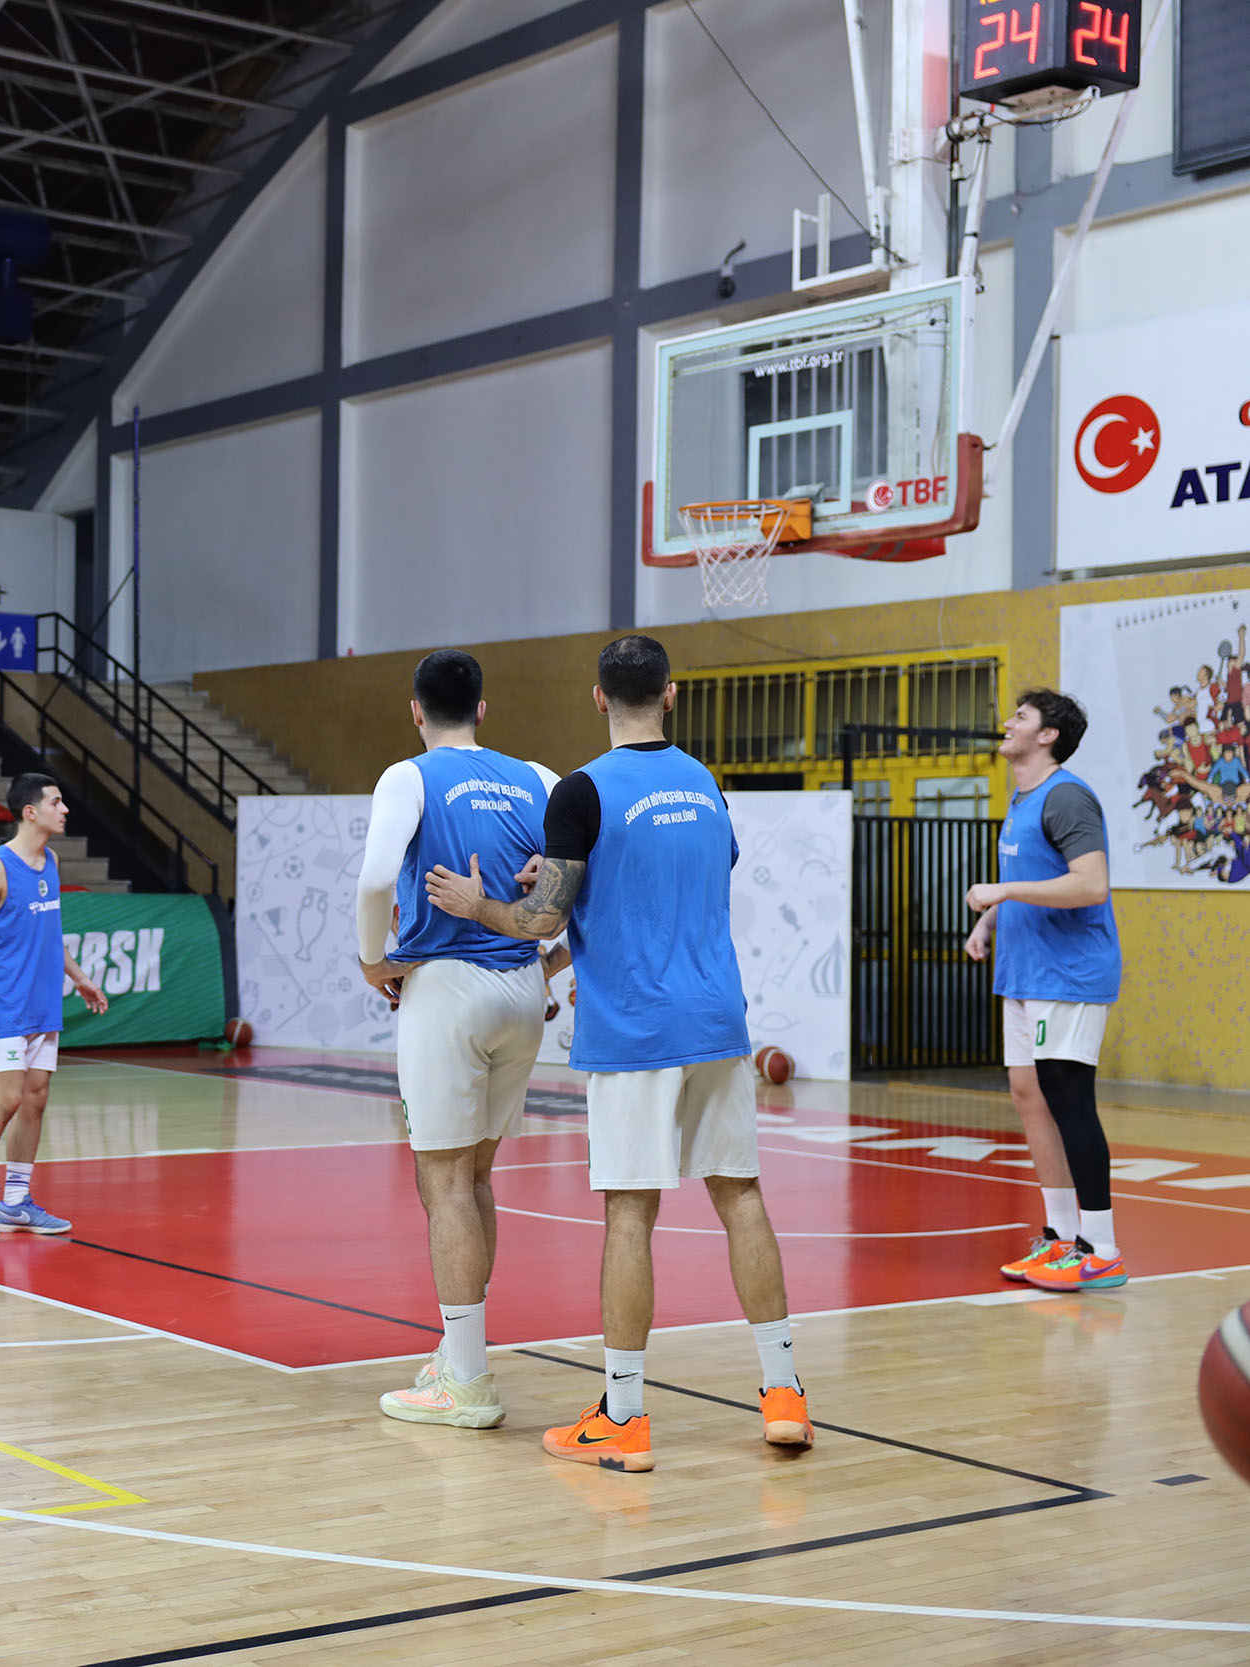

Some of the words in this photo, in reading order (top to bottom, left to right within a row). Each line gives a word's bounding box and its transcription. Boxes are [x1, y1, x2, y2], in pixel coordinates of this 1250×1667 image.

[973, 2, 1040, 79] 24
[1073, 1, 1129, 72] 24
[754, 351, 845, 378] www.tbf.org.tr
[896, 475, 948, 507] TBF
[445, 782, 469, 805] SAKARYA
[624, 796, 652, 825] SAKARYA
[652, 813, 671, 826] SPOR
